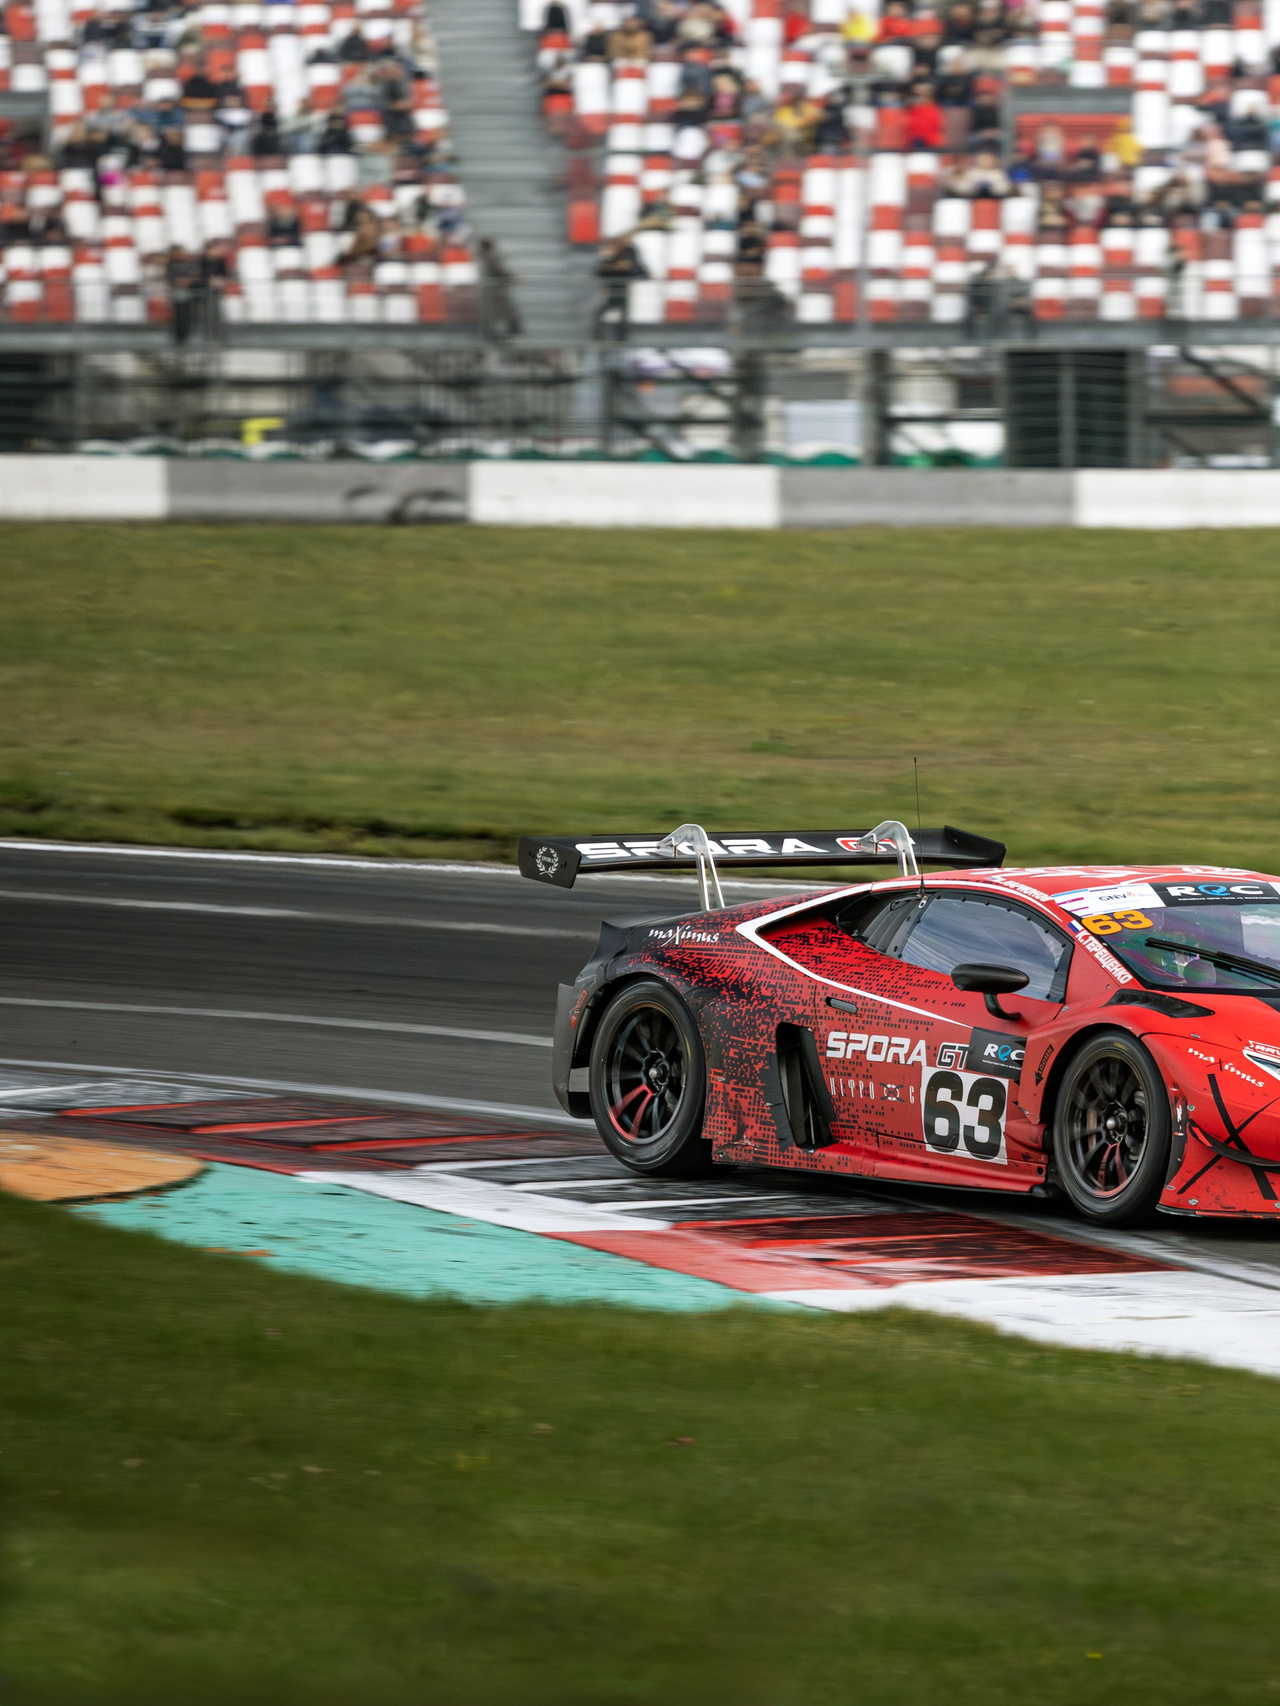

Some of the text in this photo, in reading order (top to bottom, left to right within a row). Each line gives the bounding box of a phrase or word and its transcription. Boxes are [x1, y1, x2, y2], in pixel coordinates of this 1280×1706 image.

[574, 838, 829, 860] SPORA
[1081, 910, 1153, 935] 63
[1074, 929, 1133, 985] К.ТЕРЕЩЕНКО
[826, 1031, 969, 1070] SPORA GT
[924, 1070, 1006, 1160] 63
